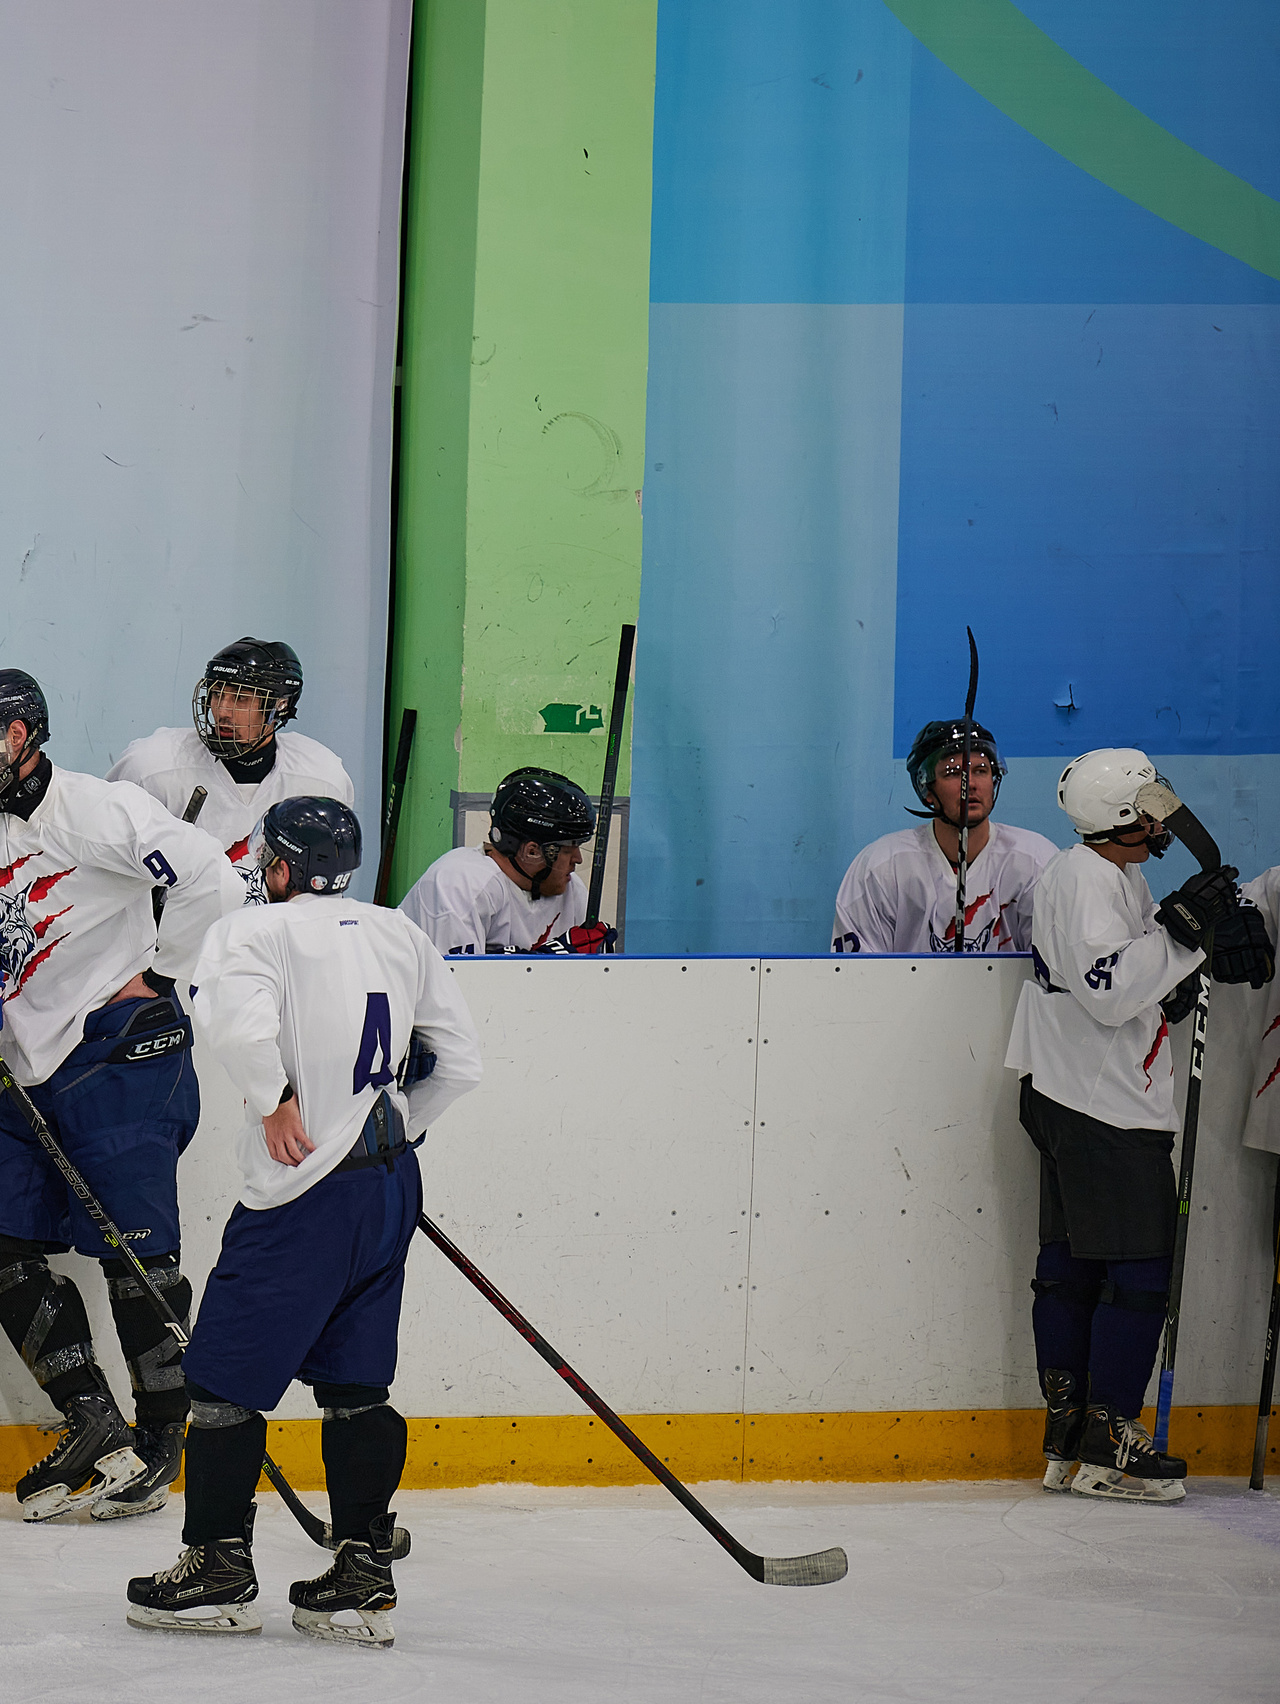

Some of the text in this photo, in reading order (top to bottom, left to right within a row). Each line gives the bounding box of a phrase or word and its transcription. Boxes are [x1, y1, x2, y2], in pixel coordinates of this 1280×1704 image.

[212, 666, 238, 675] BAUER
[385, 784, 397, 826] CCM
[527, 817, 555, 828] BAUER
[276, 835, 304, 854] BAUER
[142, 849, 178, 888] 9
[332, 872, 352, 890] 99
[1191, 972, 1211, 1081] CCM
[134, 1034, 181, 1054] CCM
[352, 992, 396, 1096] 4
[121, 1231, 147, 1240] CM
[1265, 1328, 1273, 1361] CCM
[178, 1588, 203, 1598] BAUER
